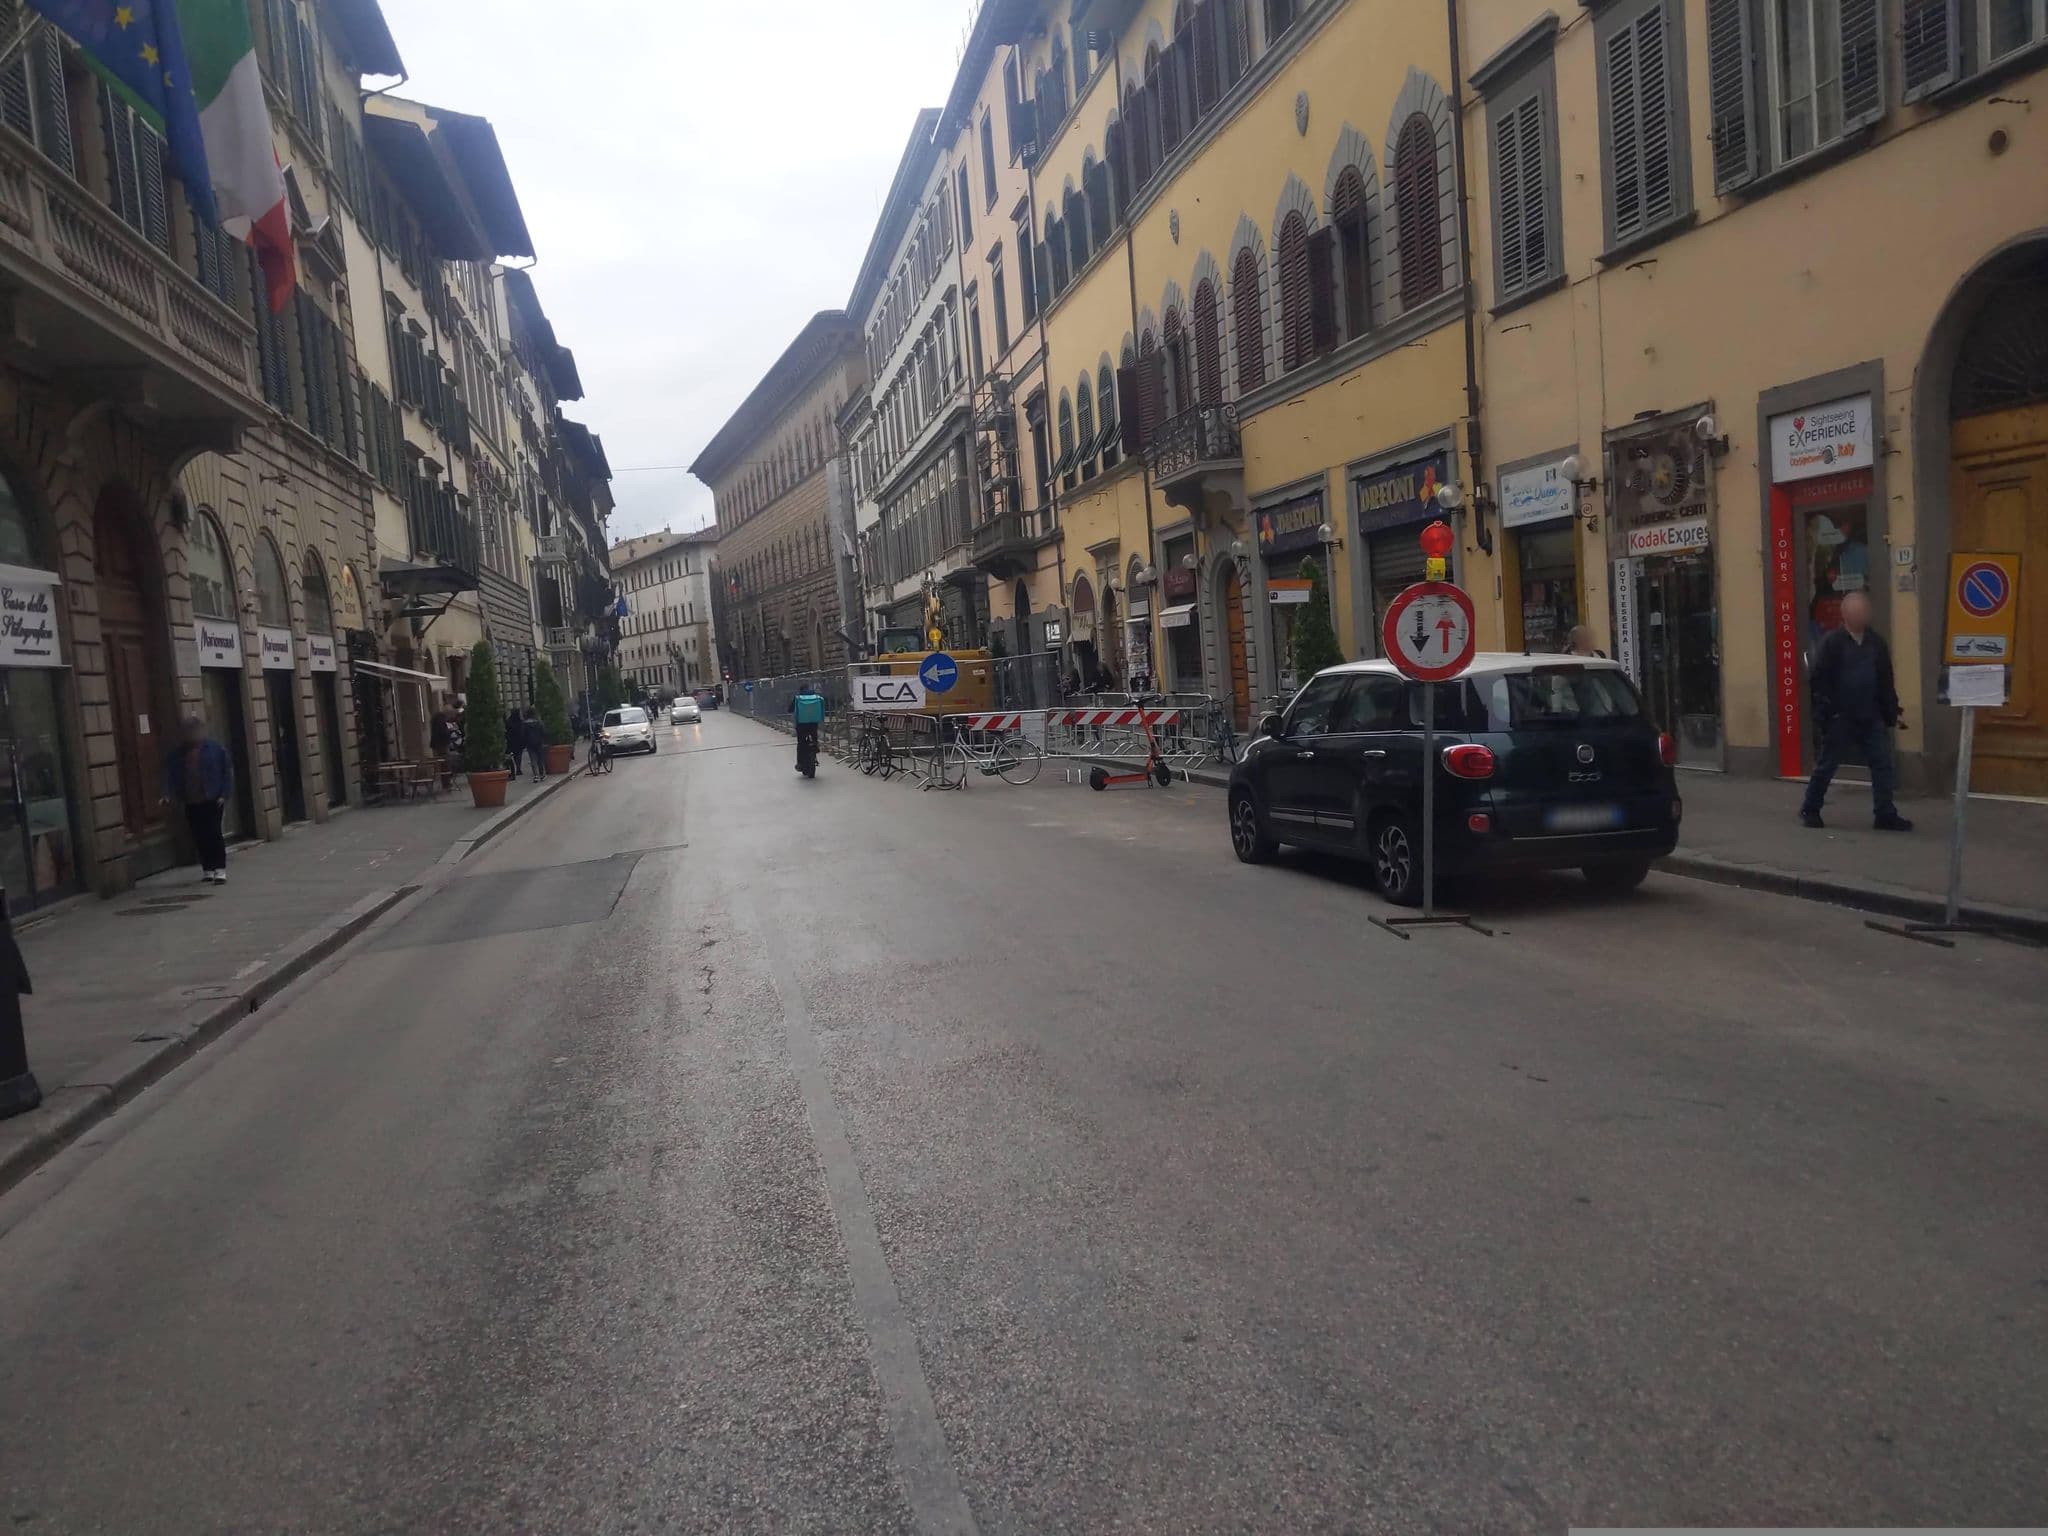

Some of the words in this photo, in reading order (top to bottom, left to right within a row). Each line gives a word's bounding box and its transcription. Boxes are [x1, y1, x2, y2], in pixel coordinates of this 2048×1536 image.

[1810, 410, 1855, 428] Sightseeing
[1788, 420, 1856, 448] EXPERIENCE
[1837, 442, 1856, 458] Italy
[1778, 528, 1788, 582] TOURS
[1781, 603, 1791, 633] HOP
[1783, 640, 1792, 659] ON
[862, 682, 918, 701] LCA
[1784, 667, 1793, 697] HOP
[1785, 704, 1794, 735] OFF
